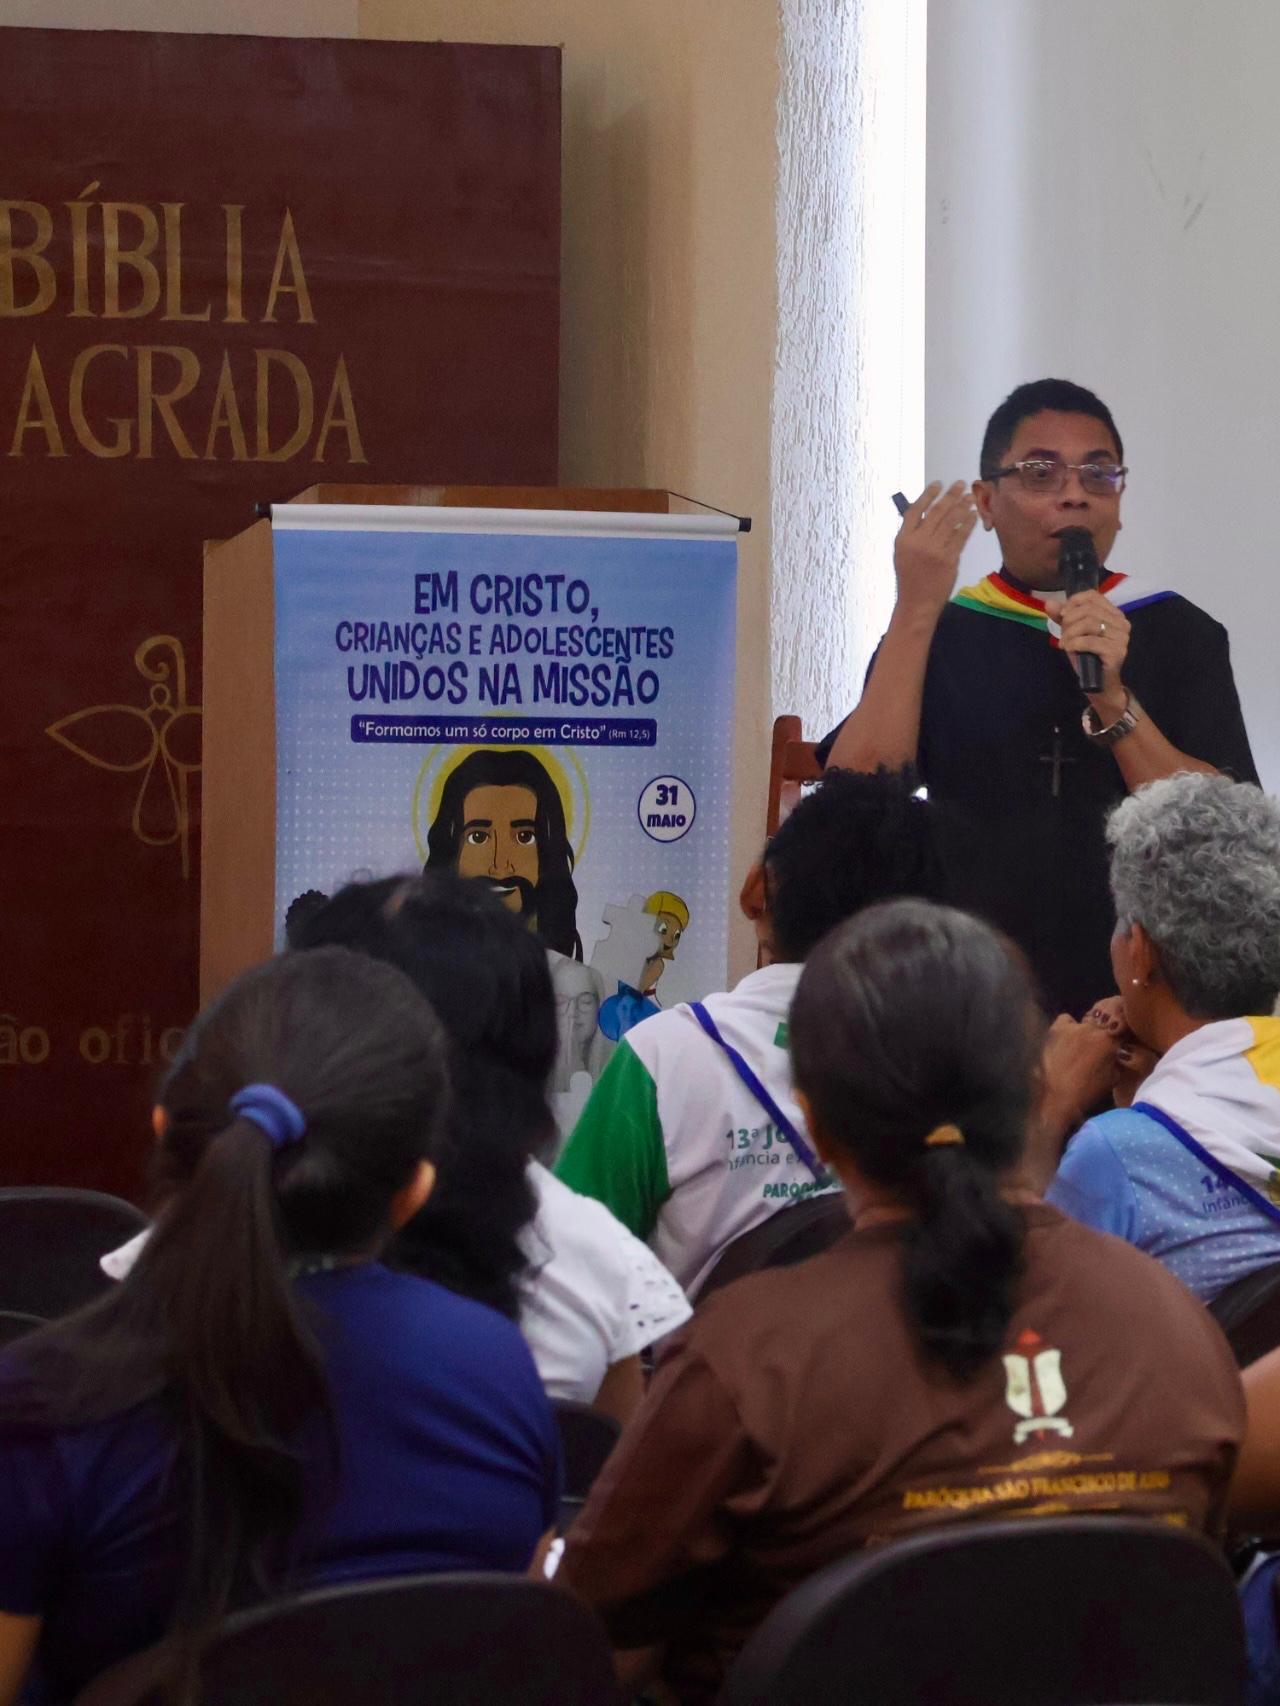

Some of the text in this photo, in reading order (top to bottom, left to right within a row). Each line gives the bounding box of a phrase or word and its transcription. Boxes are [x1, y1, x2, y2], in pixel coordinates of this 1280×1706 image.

[0, 180, 316, 323] BÍBLIA
[8, 341, 368, 465] AGRADA
[414, 570, 599, 623] EM CRISTO,
[335, 621, 675, 660] CRIANÇAS E ADOLESCENTES
[347, 655, 660, 707] UNIDOS NA MISSÃO
[446, 727, 469, 738] um
[473, 723, 487, 738] só
[491, 727, 530, 741] corpo
[534, 727, 557, 739] em
[608, 728, 627, 741] (Rm
[656, 784, 678, 806] 31
